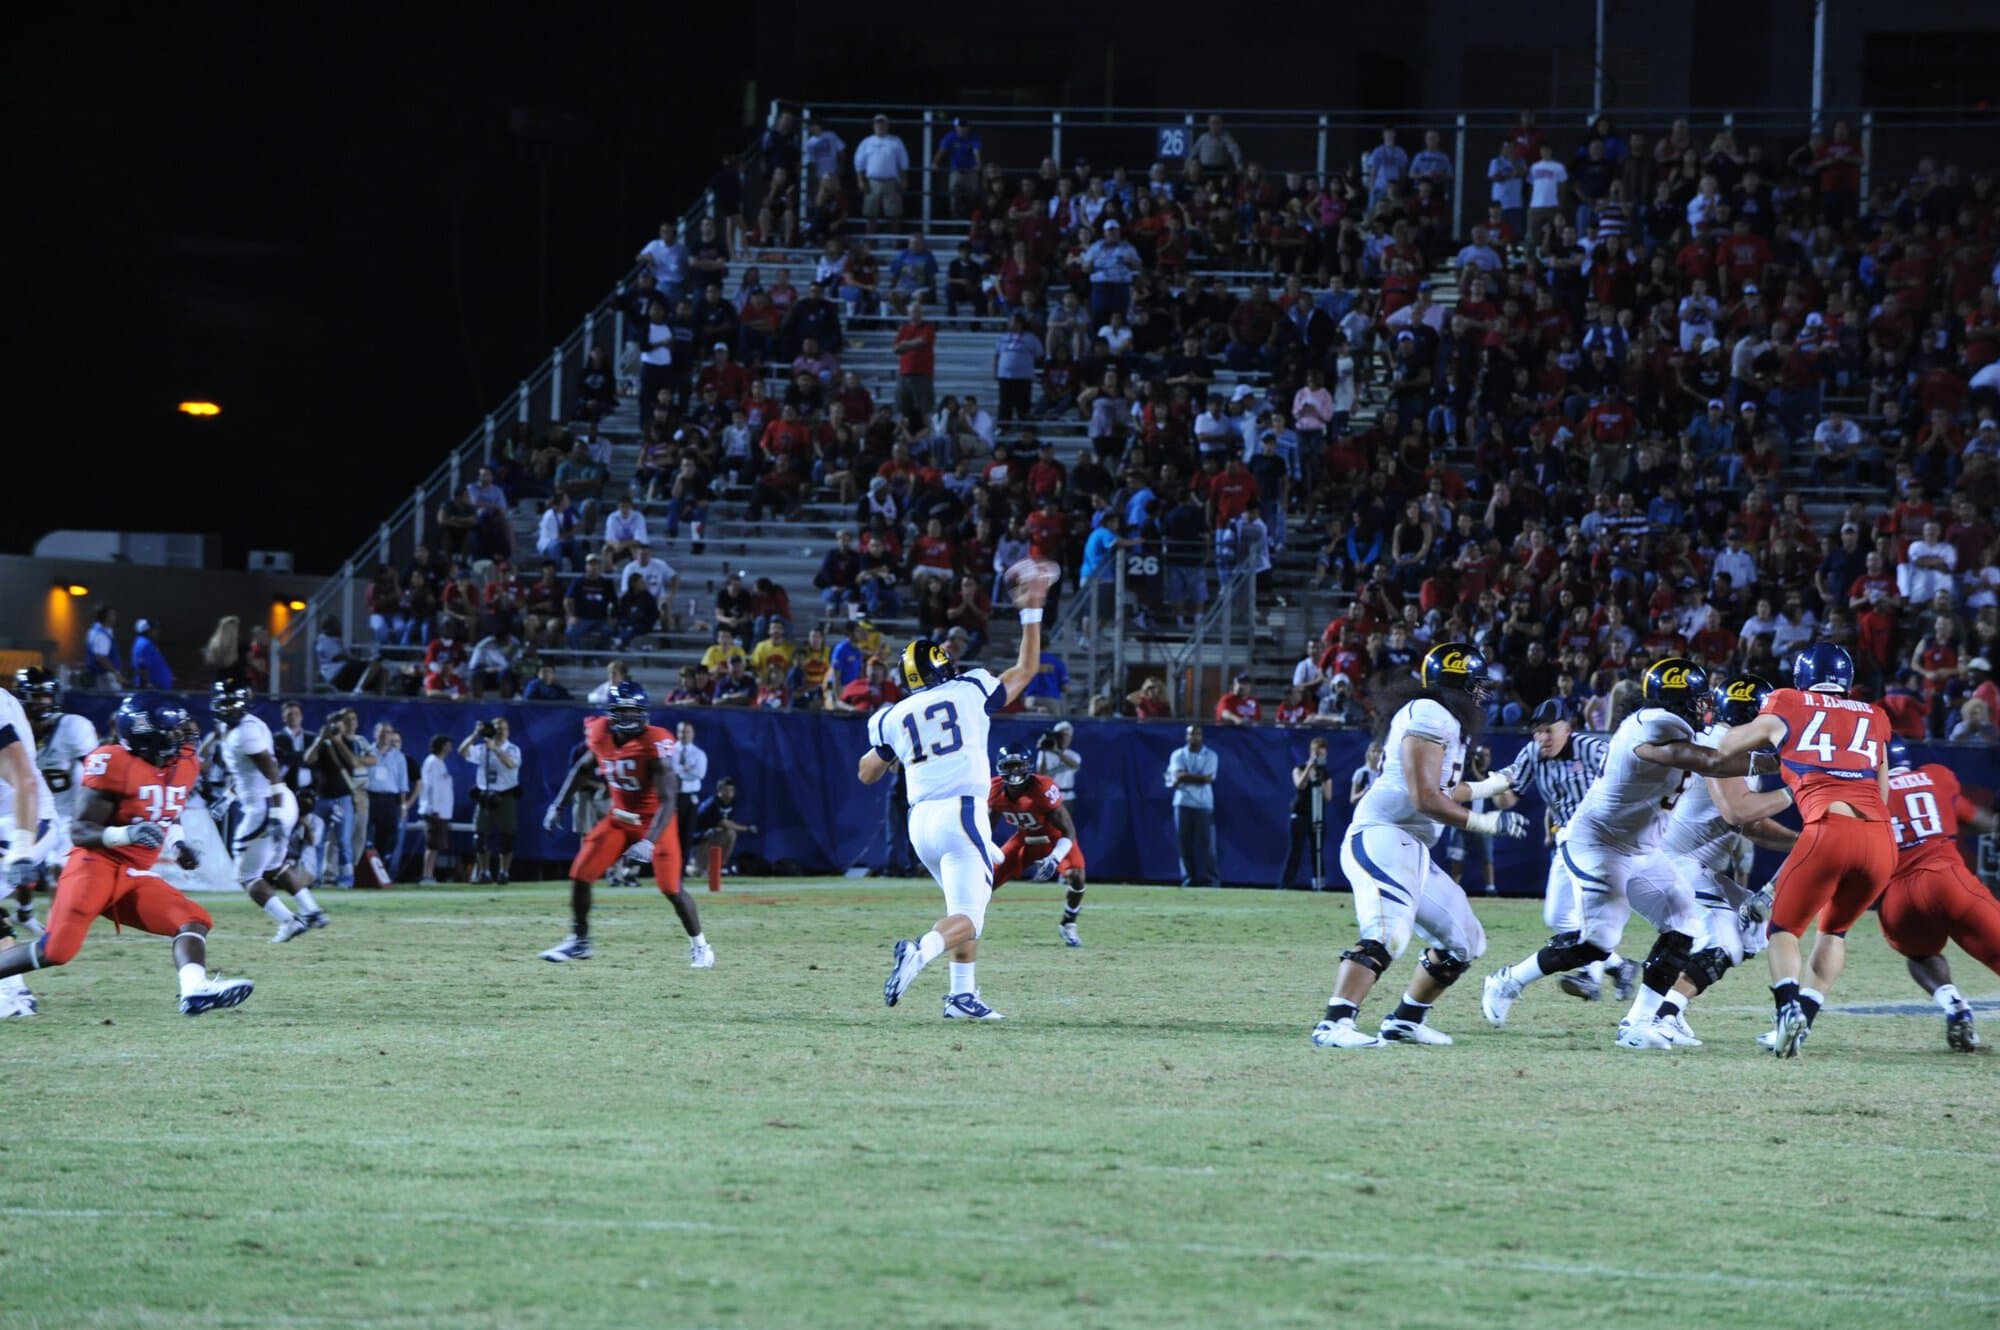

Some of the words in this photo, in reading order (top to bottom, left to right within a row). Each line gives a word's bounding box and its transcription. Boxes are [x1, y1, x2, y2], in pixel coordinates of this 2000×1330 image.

[1162, 130, 1184, 155] 26
[1128, 556, 1158, 575] 26
[1442, 651, 1472, 673] Cal
[1661, 667, 1690, 688] Cal
[1726, 681, 1756, 701] Cal
[902, 700, 963, 764] 13
[1797, 711, 1878, 768] 44
[138, 784, 187, 828] 35
